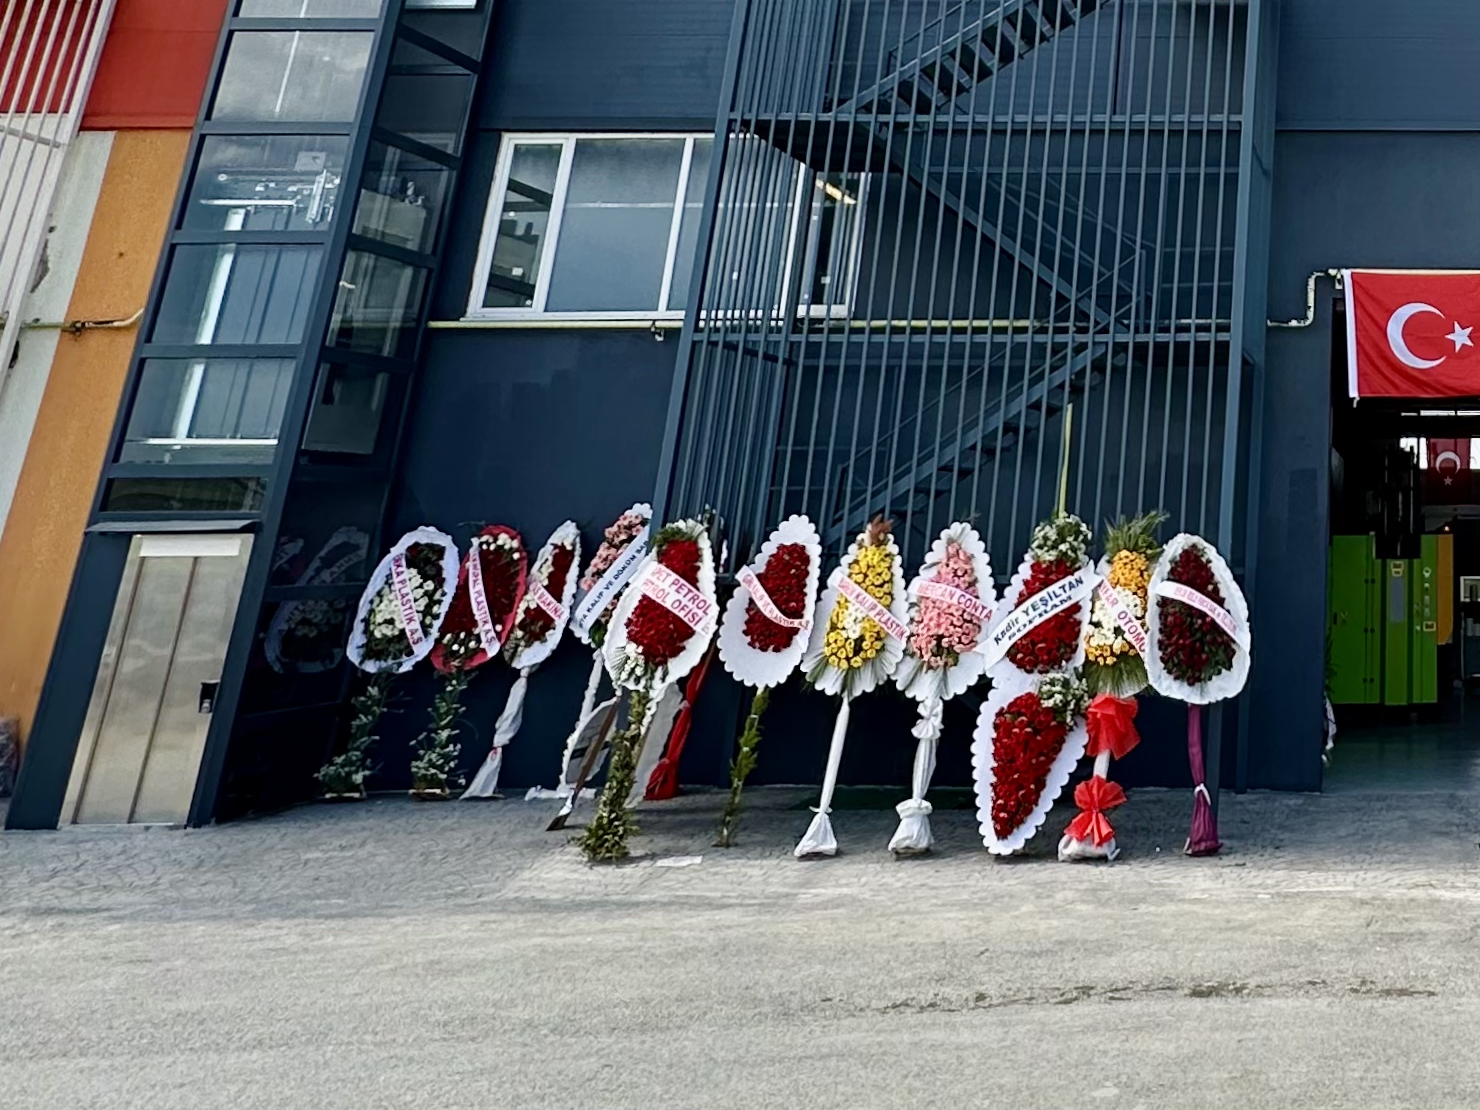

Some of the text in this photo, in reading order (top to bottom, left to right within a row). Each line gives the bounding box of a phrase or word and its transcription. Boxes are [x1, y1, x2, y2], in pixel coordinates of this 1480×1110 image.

[668, 578, 711, 616] PETROL
[956, 594, 993, 623] CONTA
[1021, 576, 1084, 617] YEŞİLTAN
